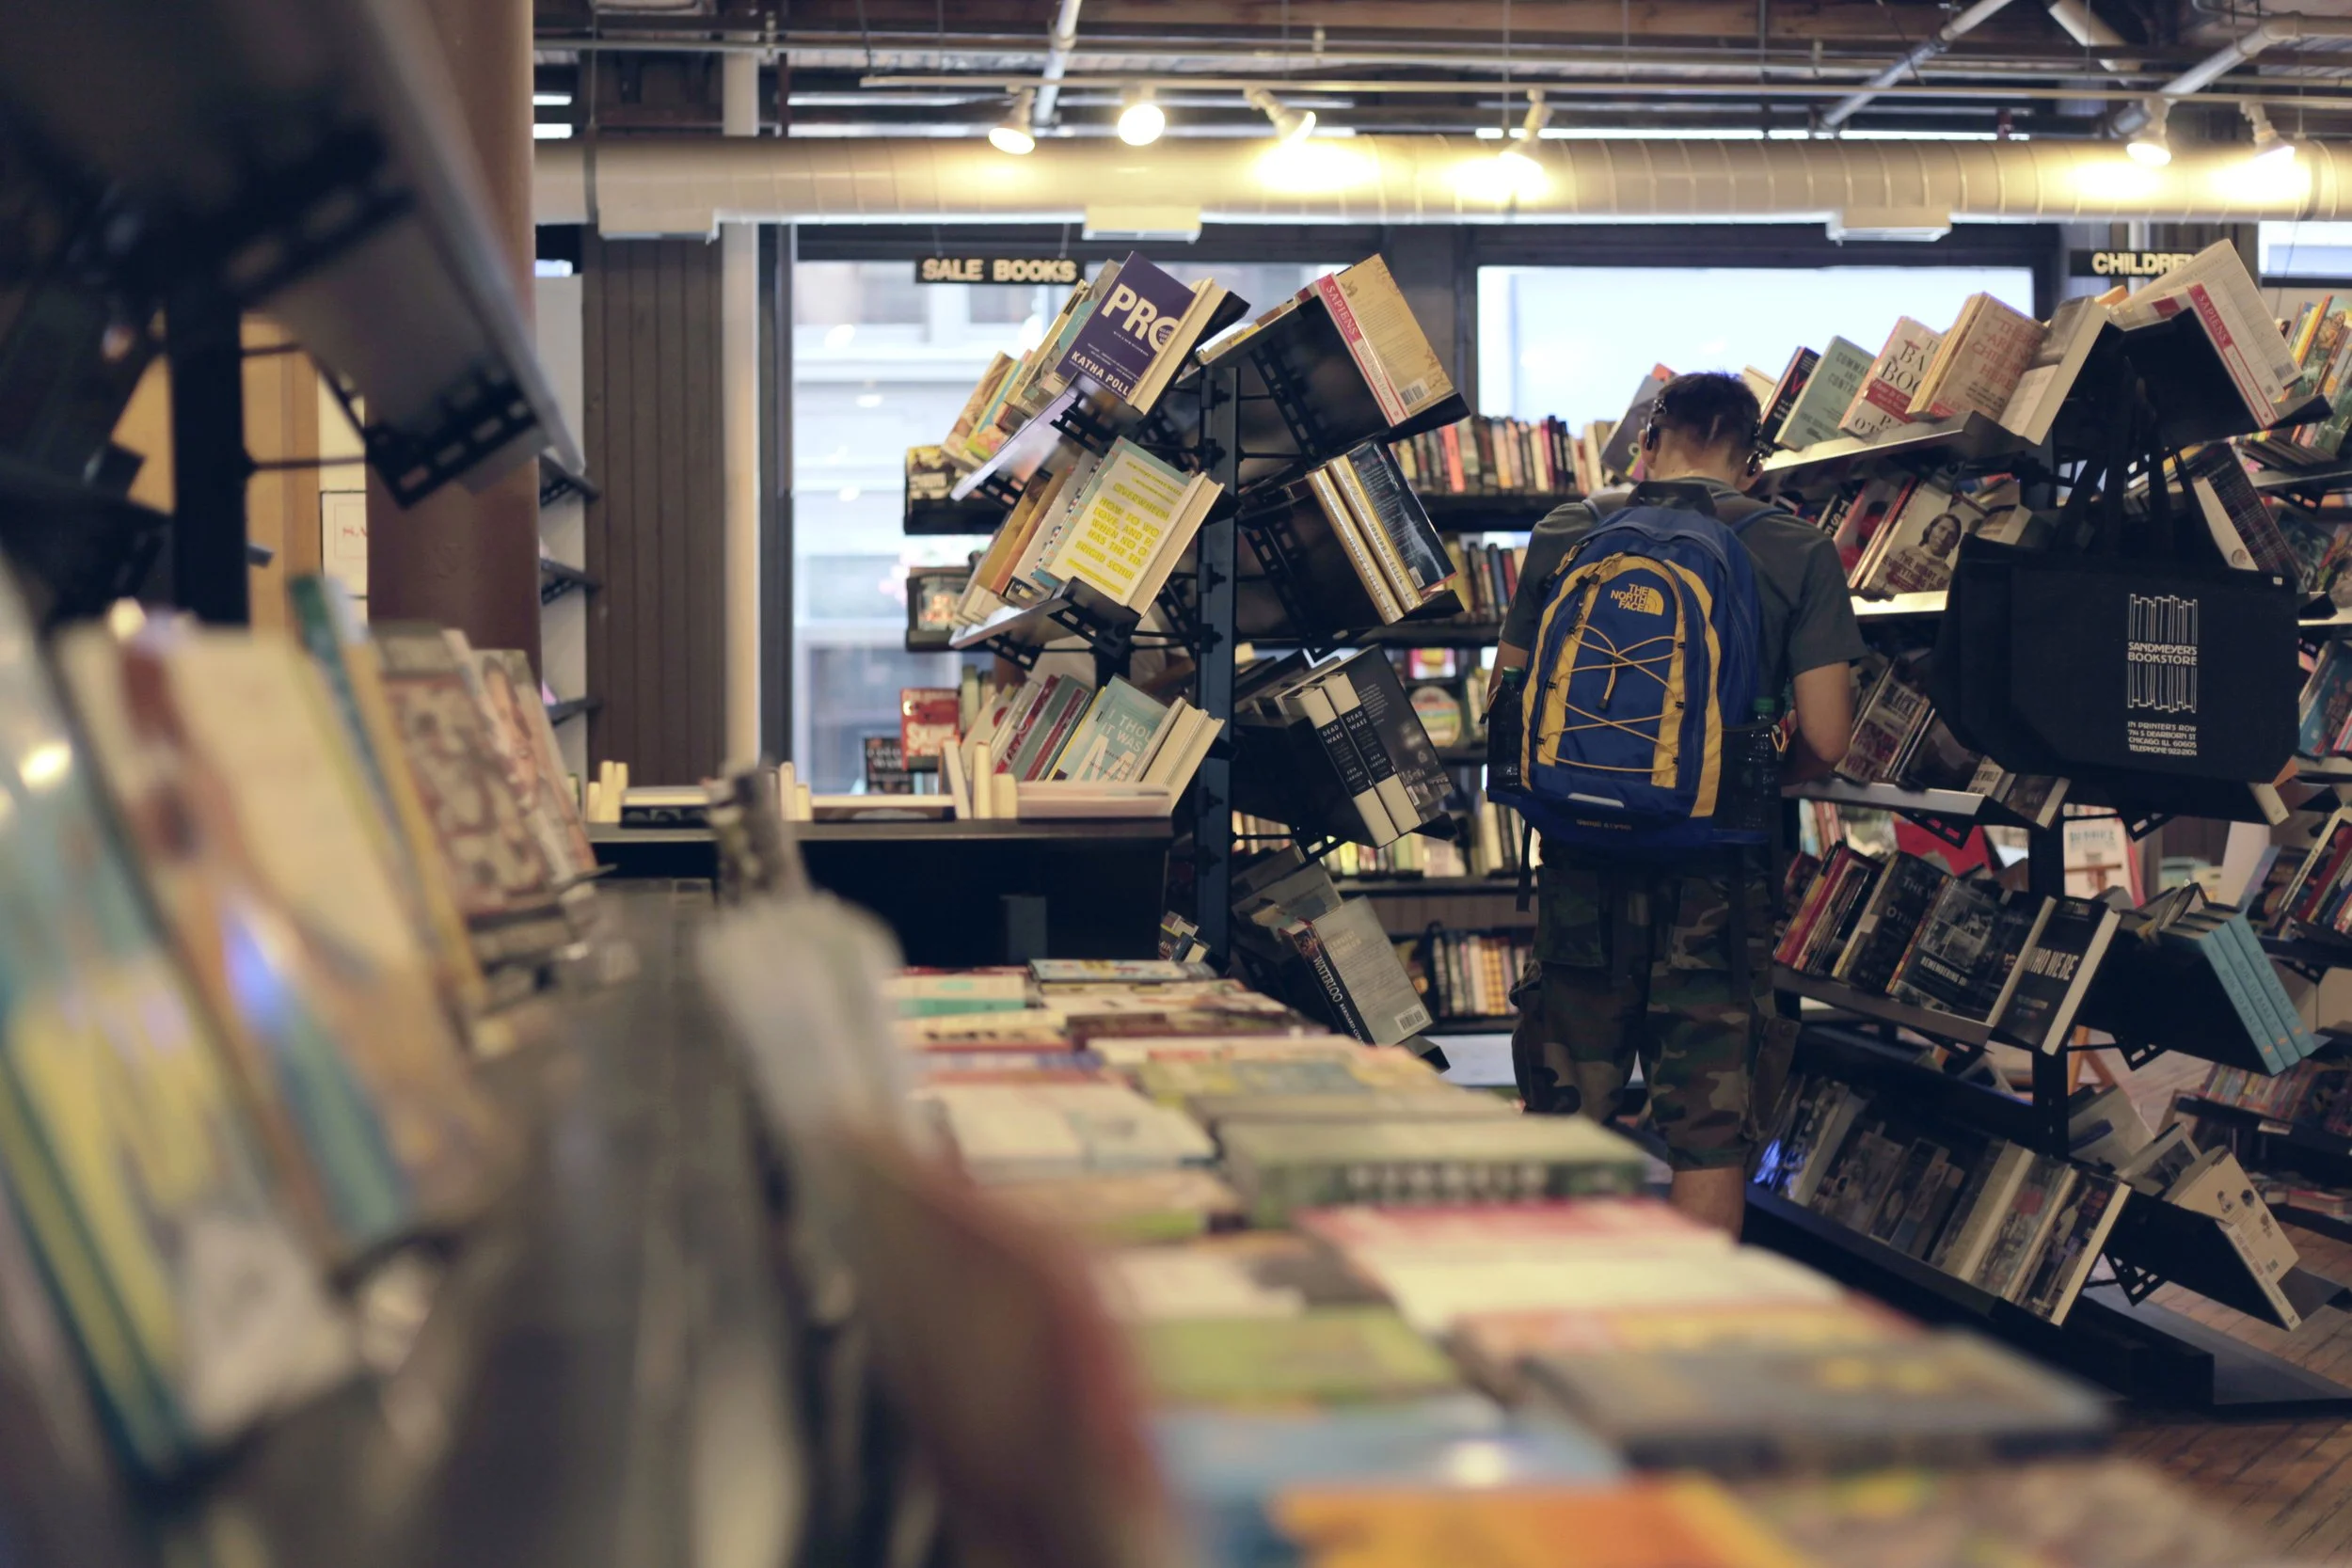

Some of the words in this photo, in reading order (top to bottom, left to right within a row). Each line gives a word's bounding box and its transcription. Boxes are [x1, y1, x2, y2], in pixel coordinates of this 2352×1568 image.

[922, 258, 983, 280] SALE
[993, 259, 1076, 282] BOOKS
[2091, 252, 2196, 275] CHILDRE
[1326, 285, 1358, 336] SAPIENS
[2198, 294, 2228, 341] SAPIENS
[1071, 351, 1104, 378] KATHA
[1105, 373, 1131, 396] POLL
[1113, 483, 1170, 522] OVERWHELM
[1099, 497, 1124, 516] HOW
[1125, 513, 1140, 527] TO
[1091, 518, 1119, 539] WHEN
[1120, 536, 1136, 550] NO
[1121, 525, 1142, 540] AND
[1088, 529, 1106, 546] HAS
[1109, 541, 1126, 557] THE
[1611, 590, 1646, 604] NORTH
[1629, 583, 1649, 596] THE
[1618, 600, 1645, 612] FACE
[2128, 651, 2198, 665] BOOKSTORE
[1346, 710, 1363, 723] DEAD
[1349, 718, 1368, 730] WAKE
[1322, 724, 1339, 736] DEAD
[2146, 731, 2187, 739] DEARBORN
[2178, 724, 2197, 733] ROW
[1117, 730, 1143, 752] WAS
[1326, 732, 1343, 744] WAKE
[2129, 744, 2167, 753] TELEPHONE
[1313, 955, 1343, 1003] WATERLOO
[1339, 1003, 1356, 1029] BERNARD
